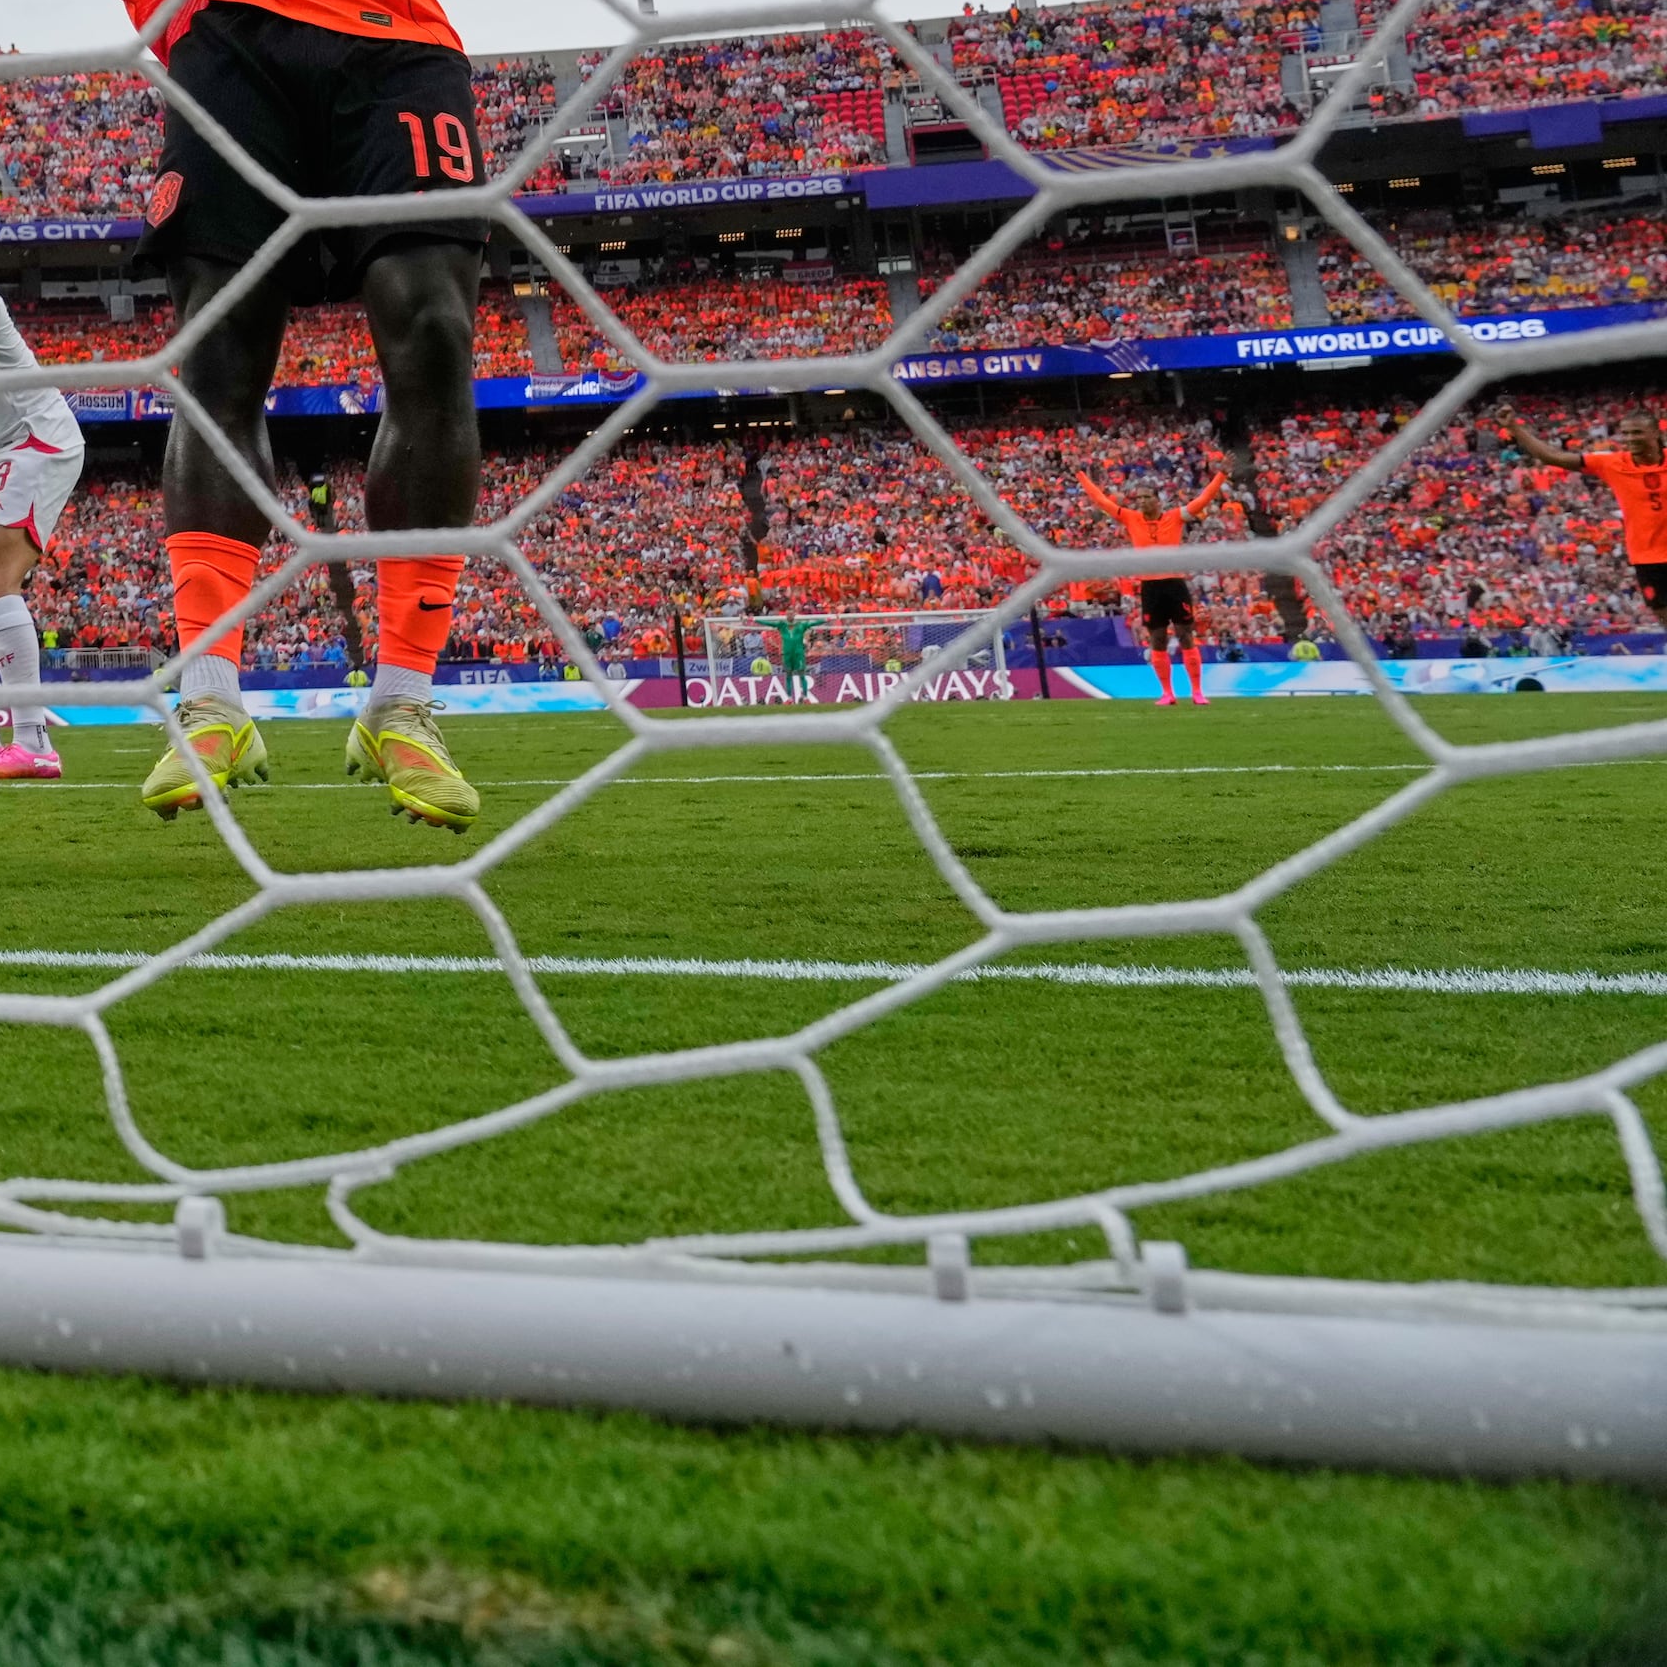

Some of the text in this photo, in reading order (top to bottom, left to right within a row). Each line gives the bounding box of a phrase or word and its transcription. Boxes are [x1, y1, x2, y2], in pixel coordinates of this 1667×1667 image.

[399, 111, 474, 183] 19
[595, 178, 843, 211] FIFA WORLD CUP 2026
[42, 223, 113, 240] CITY
[1237, 336, 1292, 358] FIFA
[1294, 330, 1390, 355] WORLD
[1391, 325, 1445, 349] CUP
[893, 353, 1043, 380] ANSAS CITY
[460, 670, 512, 685] FIFA
[686, 670, 1015, 707] QATAR AIRWAYS
